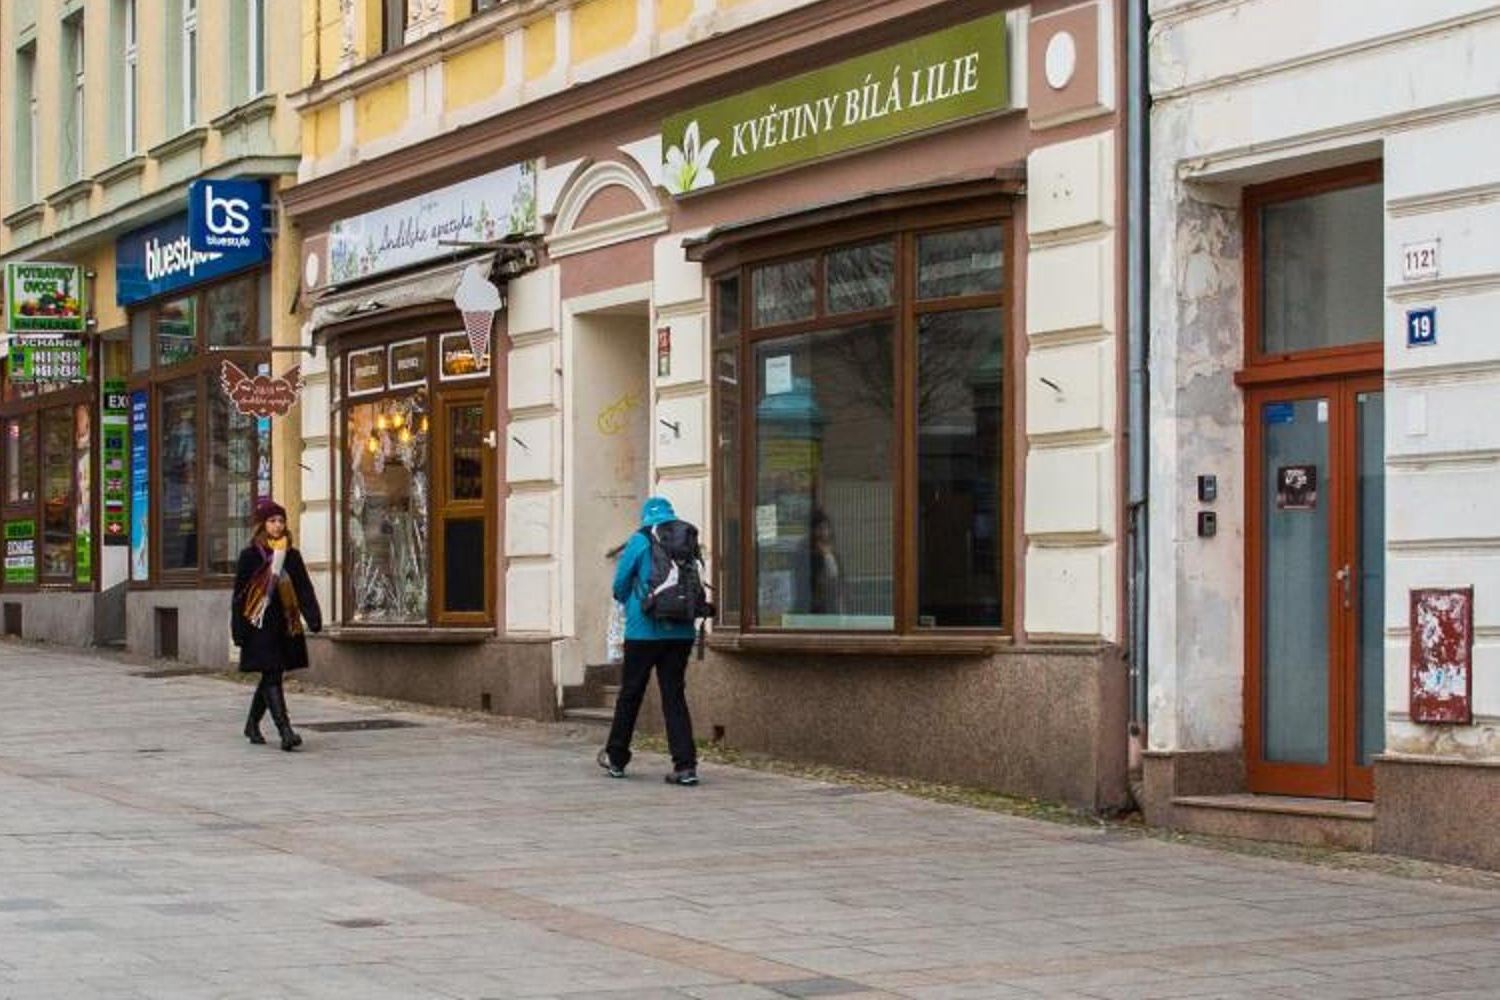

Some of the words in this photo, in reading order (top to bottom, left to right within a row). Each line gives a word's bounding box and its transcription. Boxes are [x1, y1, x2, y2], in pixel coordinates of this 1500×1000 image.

[731, 94, 839, 157] KVĚTINY
[843, 65, 902, 127] BÍLÁ
[909, 51, 979, 108] LILIE
[205, 185, 250, 235] bs
[206, 235, 250, 248] bluestyle
[1406, 248, 1437, 270] 1121
[23, 280, 58, 293] OVOCE
[1412, 316, 1431, 338] 19
